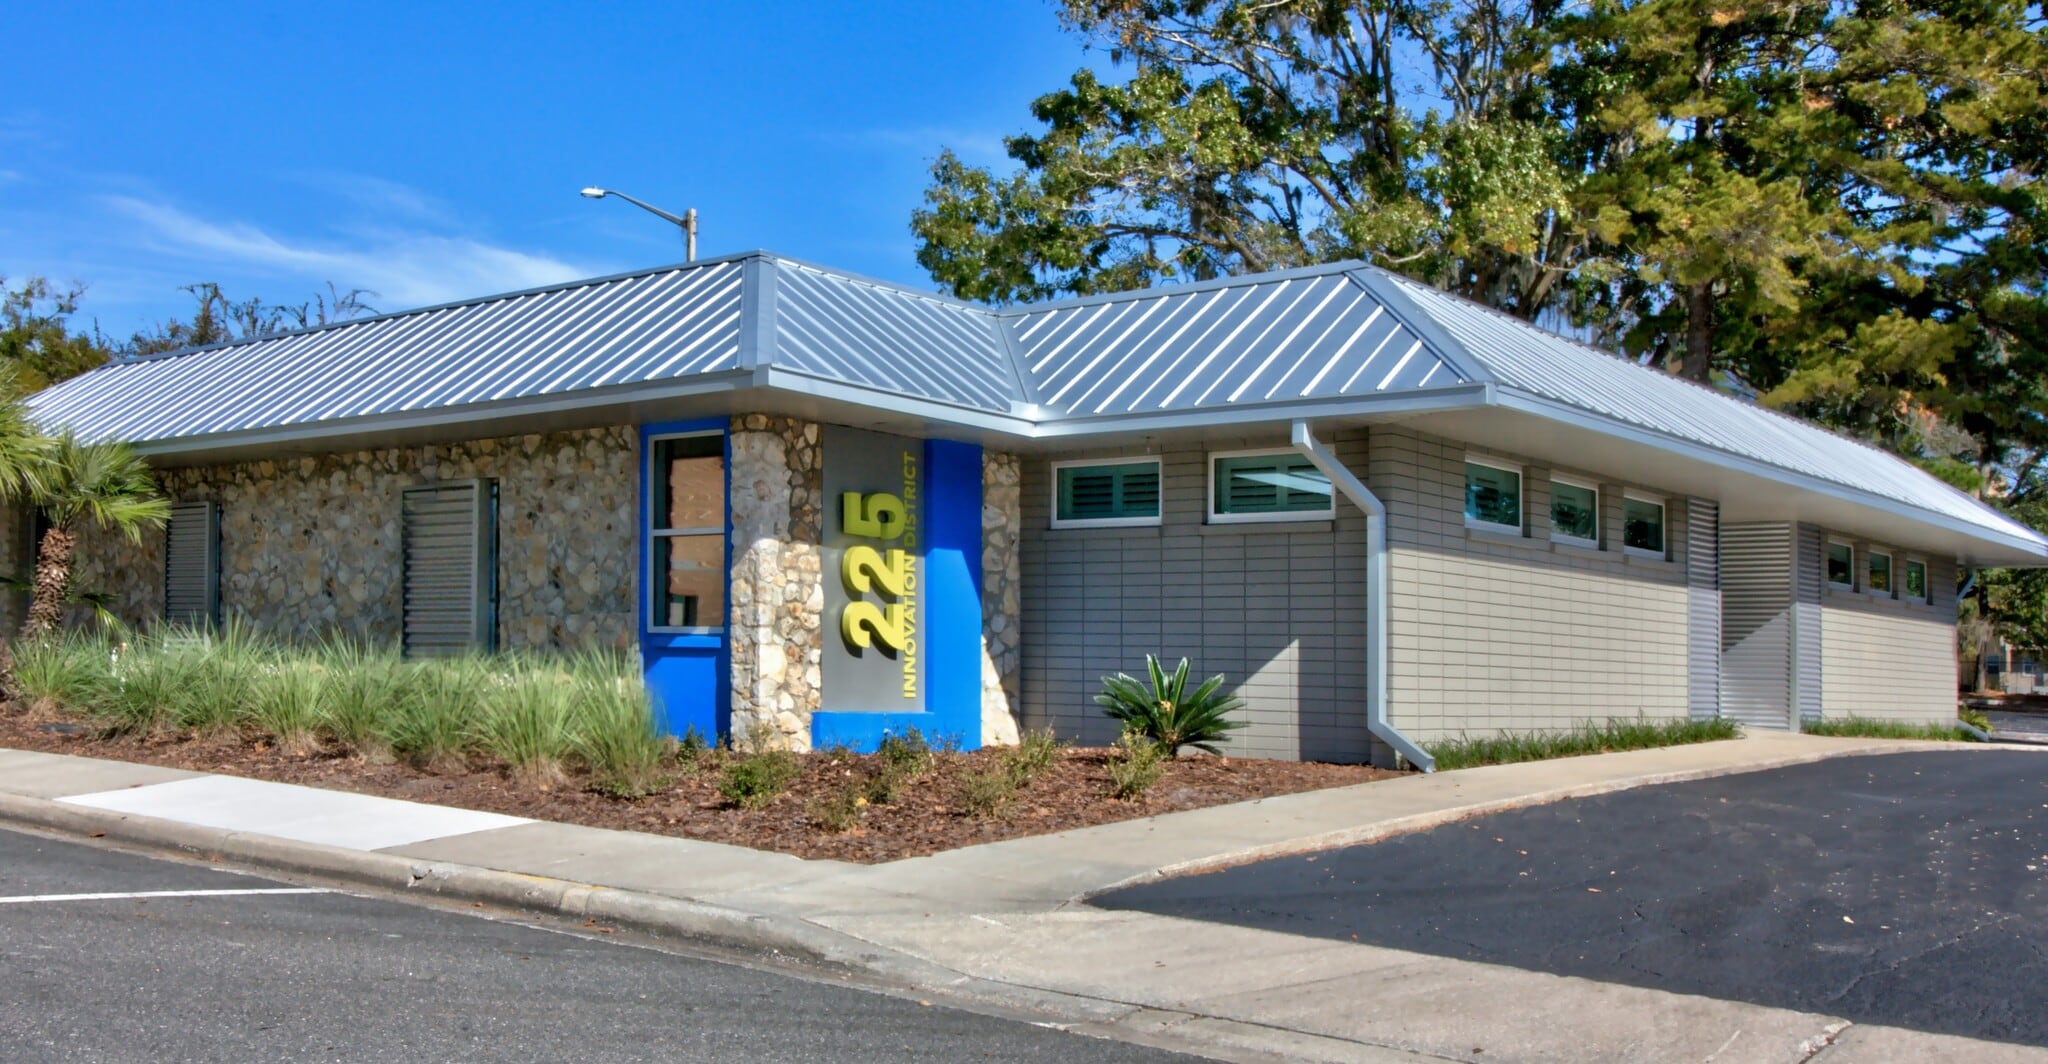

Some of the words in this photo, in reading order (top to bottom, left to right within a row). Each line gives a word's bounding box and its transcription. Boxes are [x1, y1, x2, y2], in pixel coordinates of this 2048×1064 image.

[842, 491, 906, 650] 225
[903, 451, 917, 548] DISTRICT
[903, 555, 917, 699] INNOVATION
